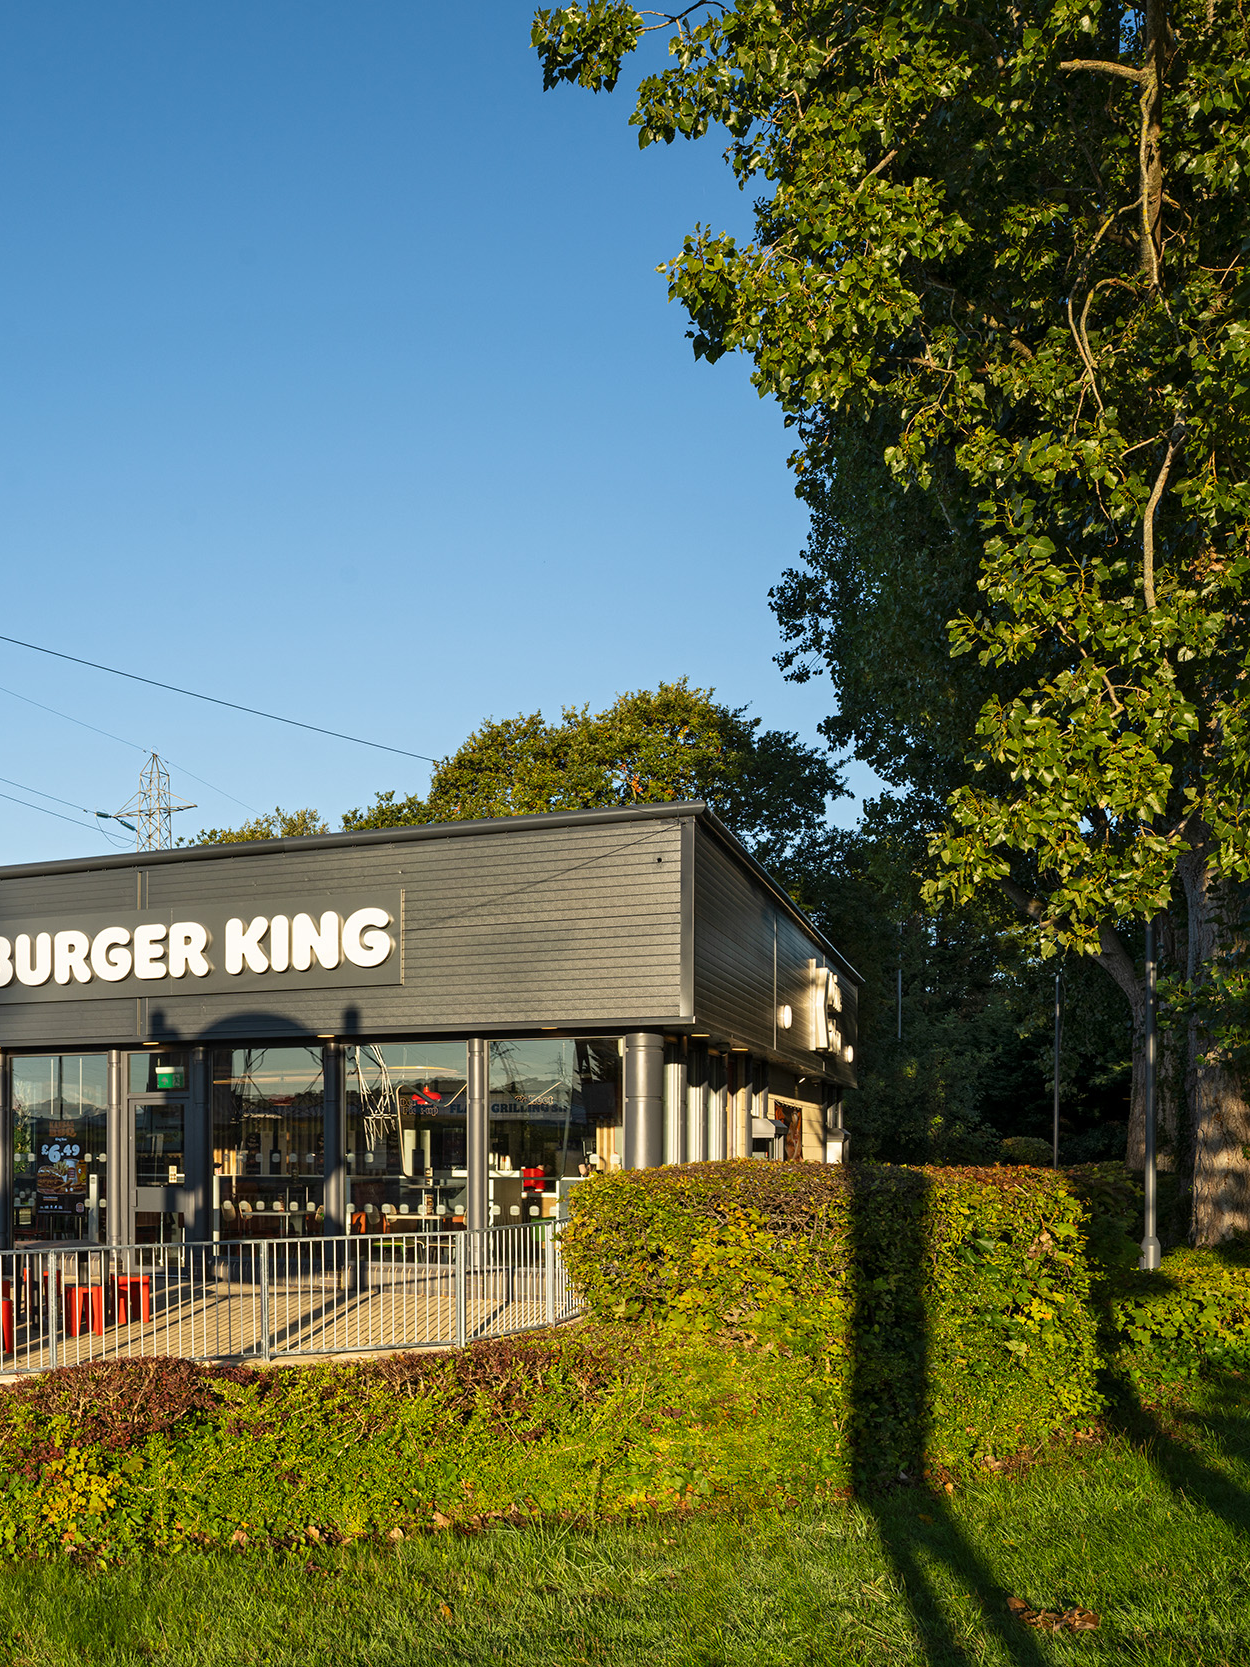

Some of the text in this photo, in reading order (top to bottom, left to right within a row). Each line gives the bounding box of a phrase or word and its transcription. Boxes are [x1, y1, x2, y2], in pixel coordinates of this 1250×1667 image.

[224, 907, 393, 975] KING
[491, 1103, 549, 1113] GRILLING
[41, 1144, 80, 1163] £6.49
